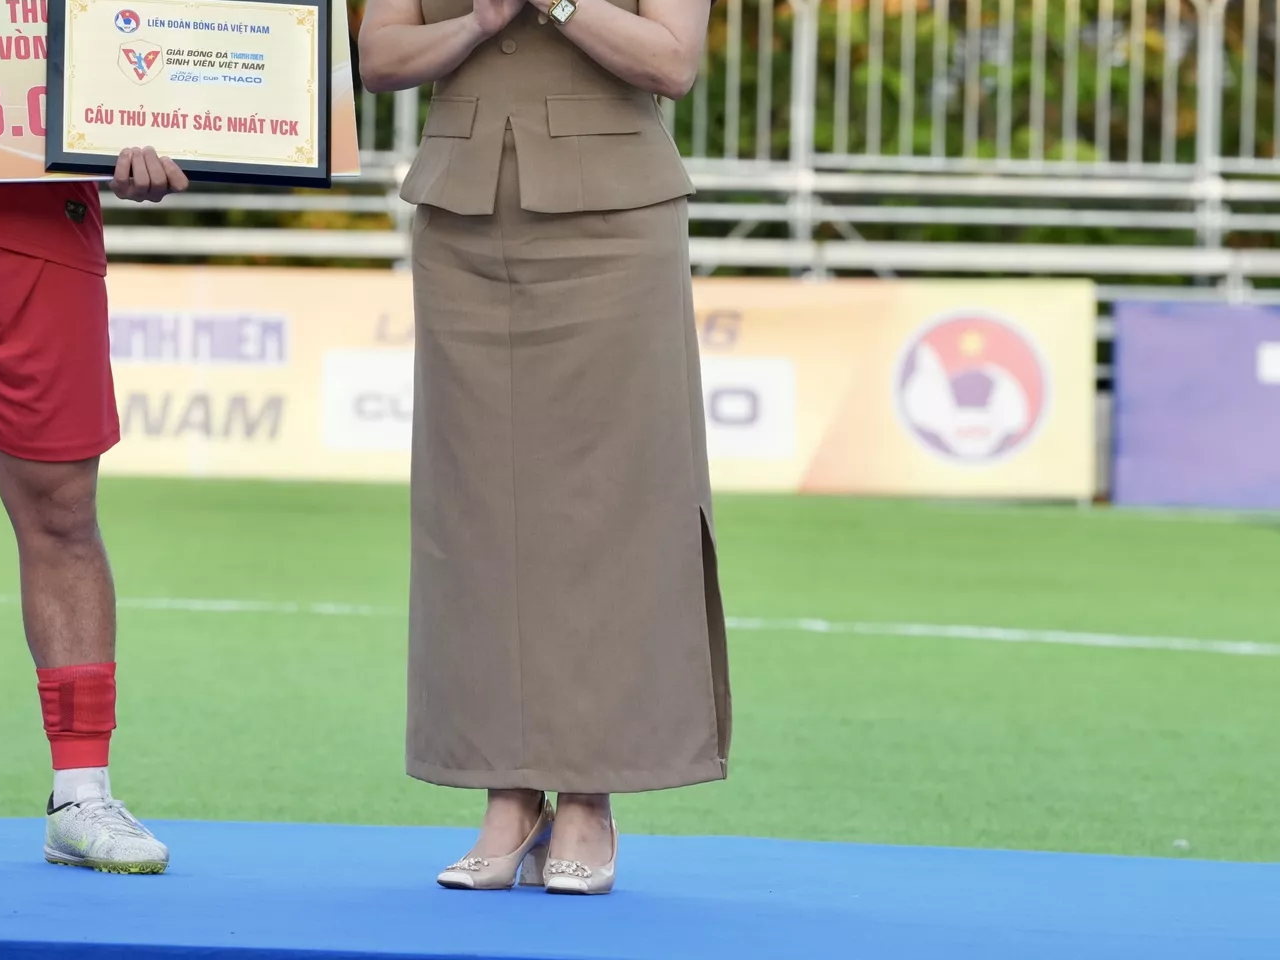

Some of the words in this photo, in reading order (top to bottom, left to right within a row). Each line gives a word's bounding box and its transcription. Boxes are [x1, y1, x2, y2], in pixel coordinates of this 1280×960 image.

[147, 17, 165, 28] LIÊN
[193, 19, 216, 31] BÓNG
[230, 22, 248, 35] VIỆT
[250, 25, 270, 34] NAM
[166, 58, 190, 66] SINH
[193, 58, 216, 67] VIÊN
[219, 60, 239, 70] VIỆT
[241, 62, 265, 71] NAM
[170, 74, 199, 82] 2026
[221, 75, 262, 83] THACO
[84, 103, 114, 125] CẦU
[118, 104, 147, 127] THỦ
[151, 108, 189, 129] XUẤT
[193, 110, 222, 131] SẮC
[227, 112, 266, 134] NHẤT
[270, 119, 299, 136] VCK
[122, 391, 285, 441] NAM
